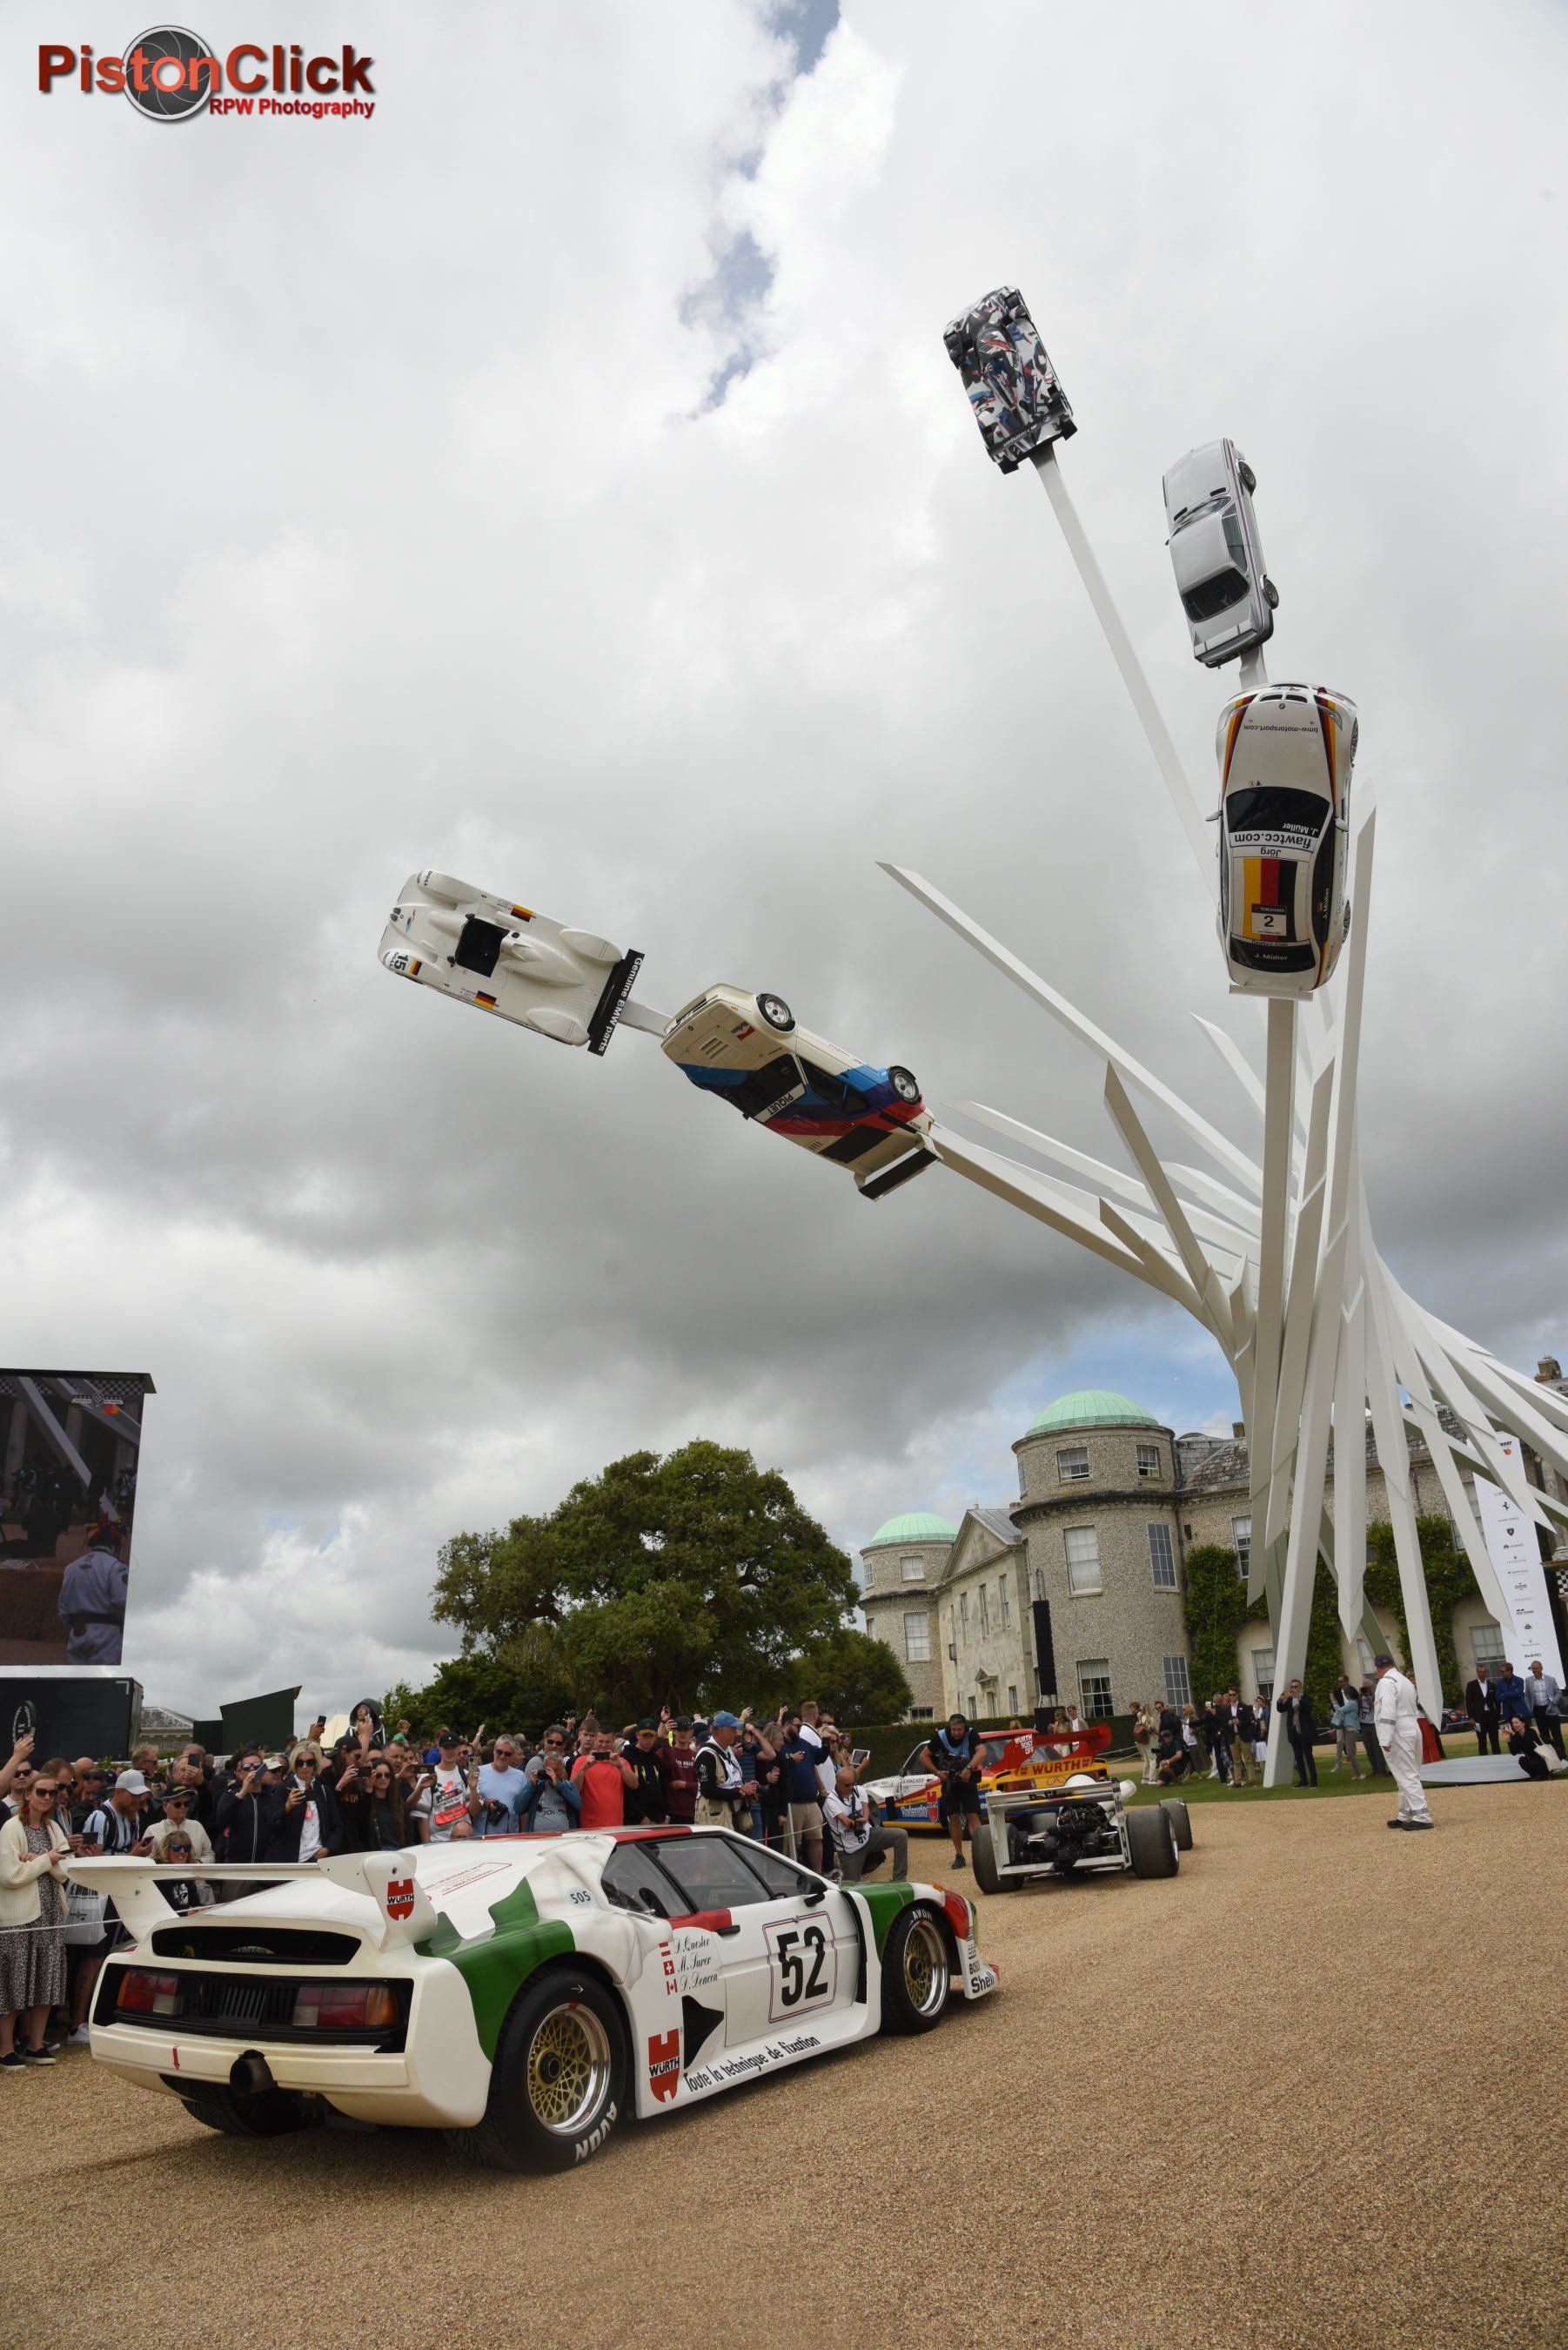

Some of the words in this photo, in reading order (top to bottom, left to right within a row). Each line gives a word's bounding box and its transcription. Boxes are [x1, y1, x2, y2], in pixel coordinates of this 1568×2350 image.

[1243, 723, 1318, 734] bmw-motorsport.com
[1282, 822, 1310, 834] Müller
[1235, 833, 1311, 849] fiawtcc.com
[1260, 847, 1282, 857] Jörg
[1263, 915, 1275, 928] 2
[393, 954, 409, 971] 15
[620, 957, 643, 997] Genuine
[610, 998, 626, 1026] BMW
[599, 1025, 613, 1051] parts
[769, 1092, 794, 1116] PIQUET
[1032, 1760, 1080, 1776] WÜRTH
[387, 1893, 414, 1904] WÜRTH
[570, 1890, 591, 1904] 505
[776, 1925, 828, 2006] 52
[970, 1971, 995, 1994] Shell
[648, 2056, 680, 2078] WÜRTH
[683, 2071, 712, 2092] Toute
[706, 2065, 724, 2082] la
[721, 2051, 770, 2078] technique
[765, 2044, 784, 2059] de
[777, 2035, 821, 2055] fixation
[575, 2101, 617, 2163] AVON
